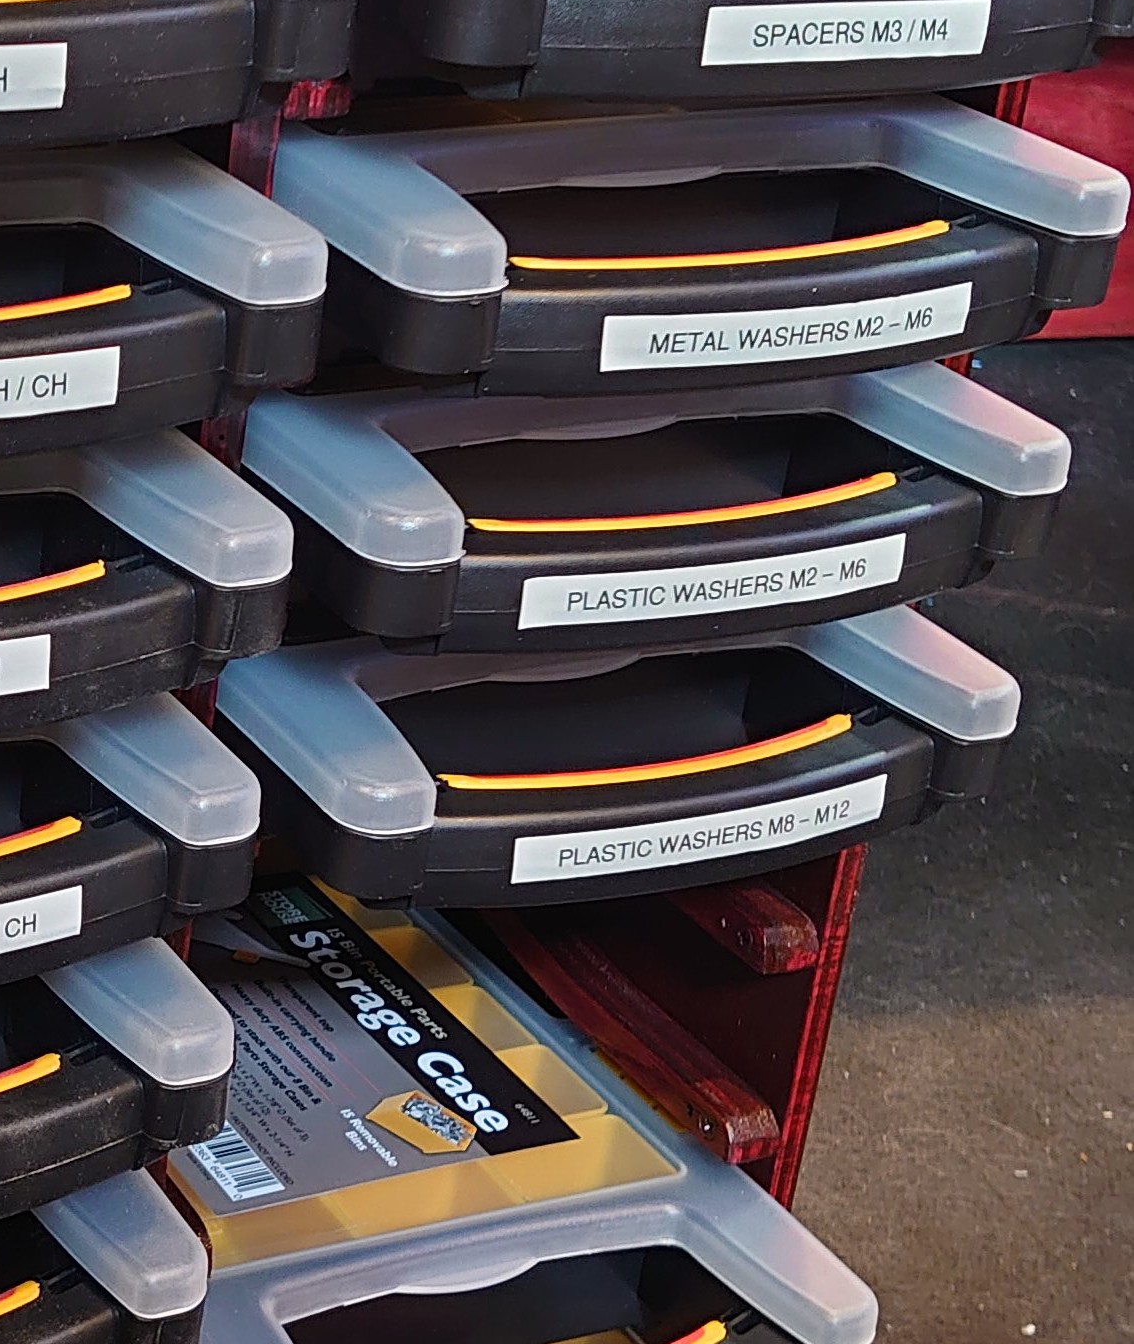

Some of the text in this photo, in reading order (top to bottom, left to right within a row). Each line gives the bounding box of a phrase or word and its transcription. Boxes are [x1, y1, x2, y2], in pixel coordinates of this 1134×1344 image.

[752, 18, 948, 48] SPACERS M3 / M4
[648, 330, 731, 355] METAL
[738, 320, 850, 350] WASHERS
[853, 315, 884, 340] M2
[904, 306, 933, 332] M6
[15, 376, 25, 401] /
[31, 372, 67, 399] CH
[567, 585, 666, 612] PLASTIC
[673, 572, 784, 604] WASHERS
[788, 566, 818, 590] M2
[839, 558, 867, 582] M6
[558, 839, 653, 868] PLASTIC
[658, 820, 763, 855] WASHERS
[768, 813, 795, 837] M8
[814, 799, 850, 826] M12
[4, 913, 37, 939] CH
[272, 890, 310, 923] STORE
[326, 927, 448, 1040] 15 Bin Portable Parts
[280, 1007, 311, 1036] carrying
[308, 1037, 335, 1061] handle
[289, 930, 509, 1134] Storage Case
[318, 1018, 334, 1032] top
[237, 1019, 248, 1028] to
[245, 1028, 266, 1047] stack
[264, 1047, 282, 1064] with
[279, 1065, 295, 1077] our
[298, 1084, 313, 1097] Bin
[239, 1041, 307, 1111] Parts Storage Cases
[269, 1025, 289, 1041] ABS
[286, 1041, 332, 1087] construction
[340, 1108, 397, 1166] 15 Removable
[345, 1130, 367, 1150] Bins
